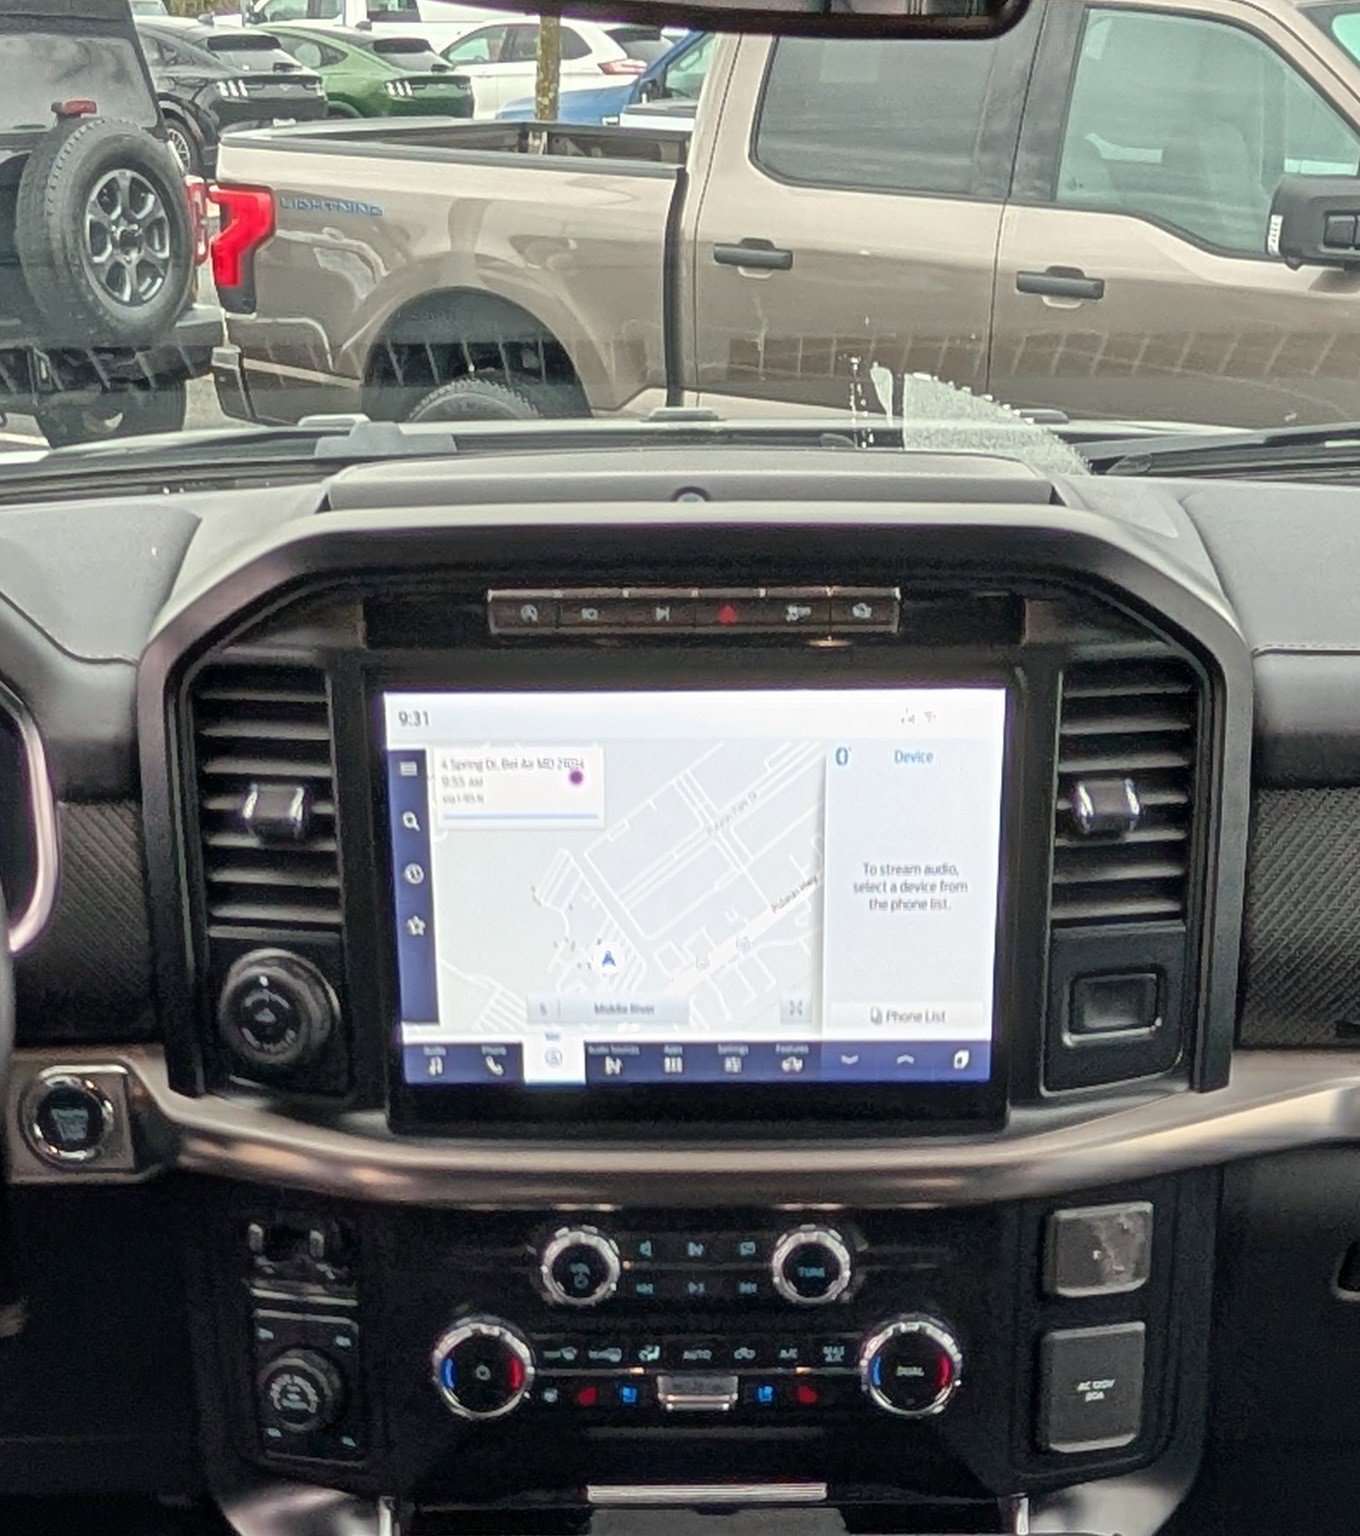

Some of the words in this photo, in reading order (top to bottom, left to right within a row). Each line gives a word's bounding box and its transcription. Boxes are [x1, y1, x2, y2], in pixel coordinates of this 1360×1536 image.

[399, 711, 430, 727] 9:31
[894, 750, 934, 764] Device
[863, 863, 877, 876] To
[880, 863, 921, 876] stream
[853, 880, 887, 893] select
[900, 880, 937, 893] device
[940, 880, 968, 893] from
[869, 898, 888, 910] the
[890, 898, 928, 912] phone
[886, 1009, 923, 1023] Phone
[925, 1008, 946, 1022] List
